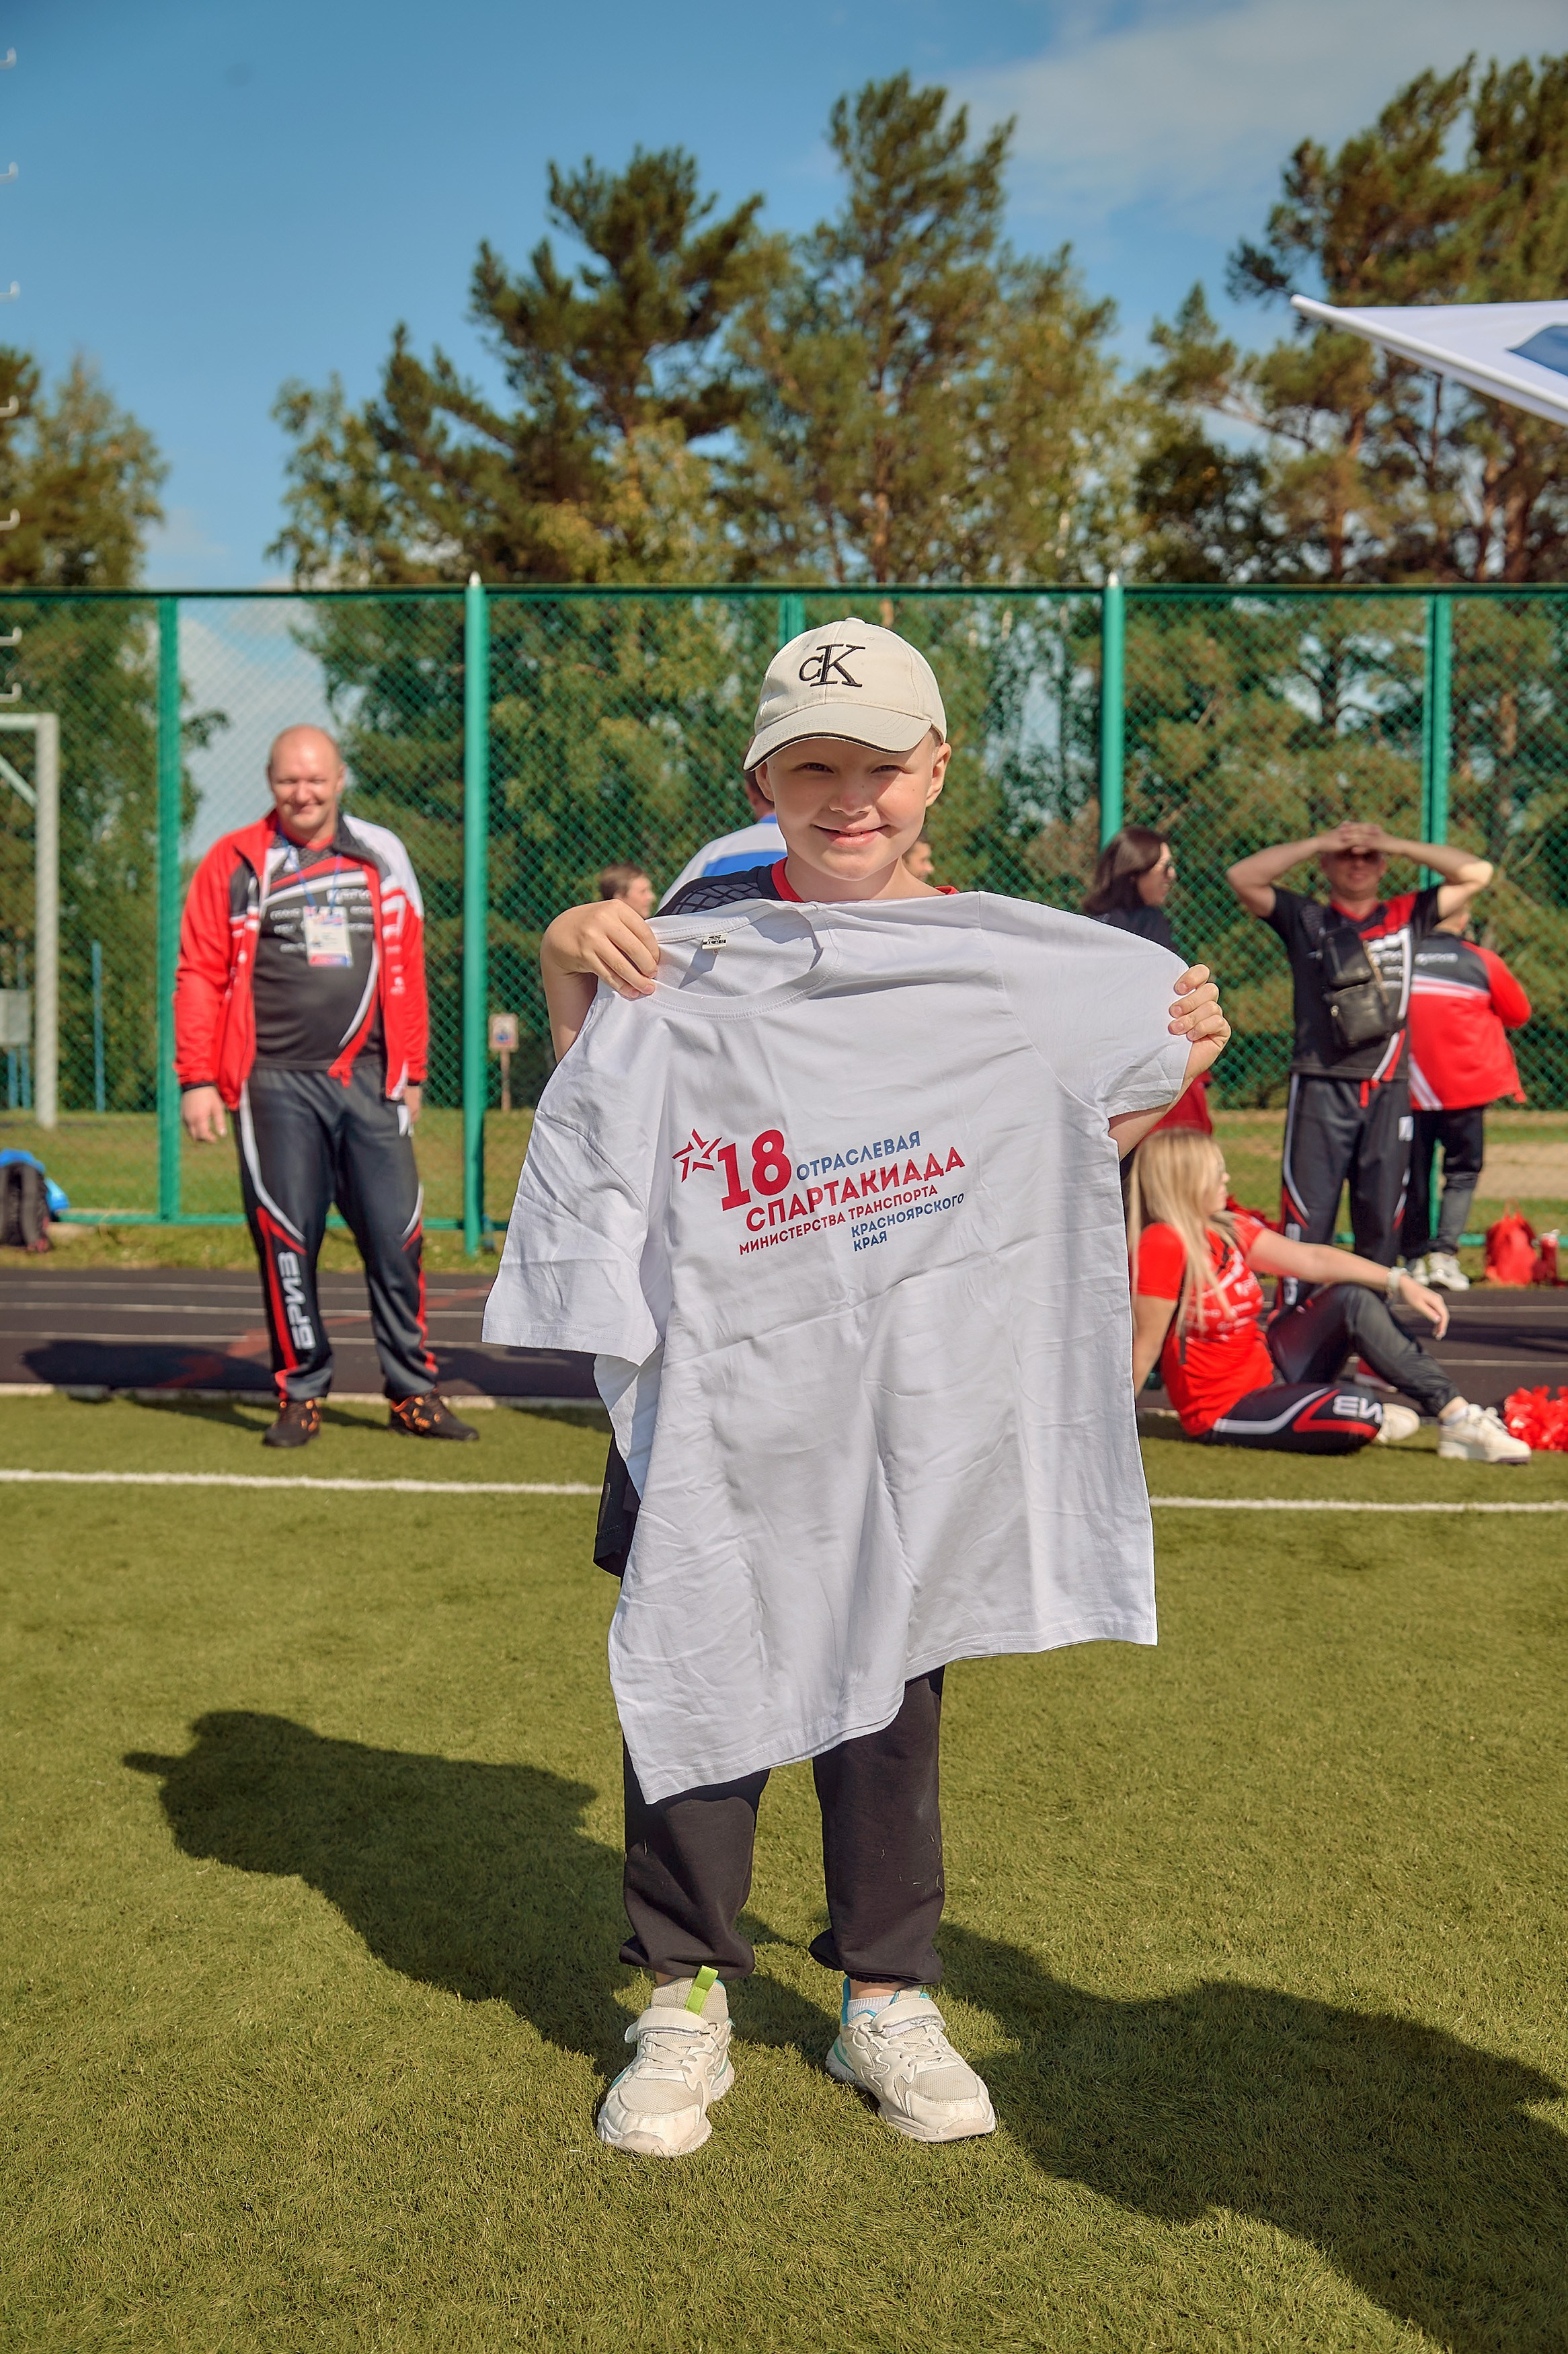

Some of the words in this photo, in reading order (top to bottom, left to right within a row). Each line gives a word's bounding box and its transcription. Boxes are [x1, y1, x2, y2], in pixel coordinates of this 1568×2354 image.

[717, 1129, 791, 1211] 18
[796, 1131, 920, 1181] ОТРАСЛЕВАЯ
[746, 1147, 966, 1232] СПАРТАКИАДА
[739, 1212, 845, 1254] МИНИСТЕРСТВА
[848, 1184, 938, 1219] ТРАНСПОРТА
[851, 1192, 965, 1238] КРАСНОЯРСКОГО
[853, 1230, 888, 1252] КРАЯ
